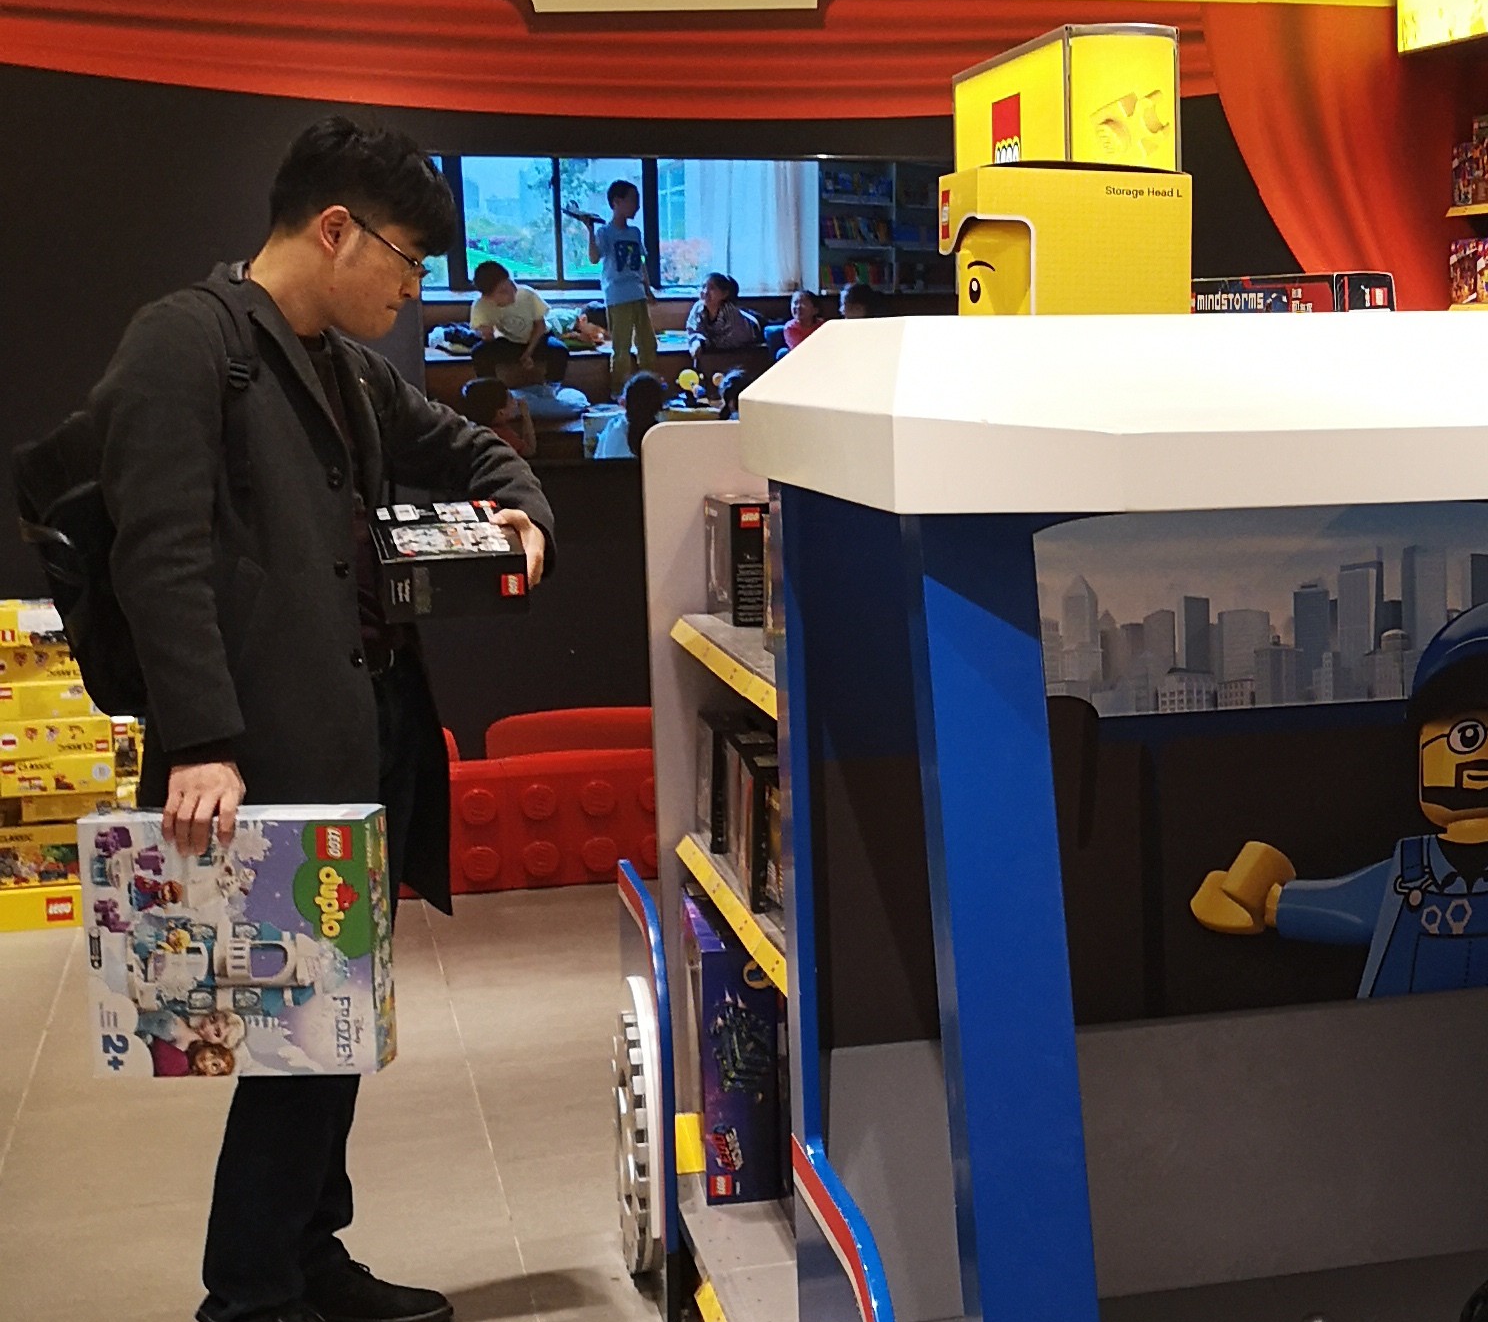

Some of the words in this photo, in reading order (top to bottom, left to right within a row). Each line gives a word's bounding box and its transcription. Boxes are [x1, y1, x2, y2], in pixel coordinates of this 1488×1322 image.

[1105, 185, 1145, 198] Storage
[1147, 187, 1174, 197] Head
[1176, 189, 1183, 198] L
[326, 827, 344, 859] LEGO
[48, 900, 72, 914] LEGO
[314, 865, 346, 938] duplo
[101, 1033, 130, 1071] 2+
